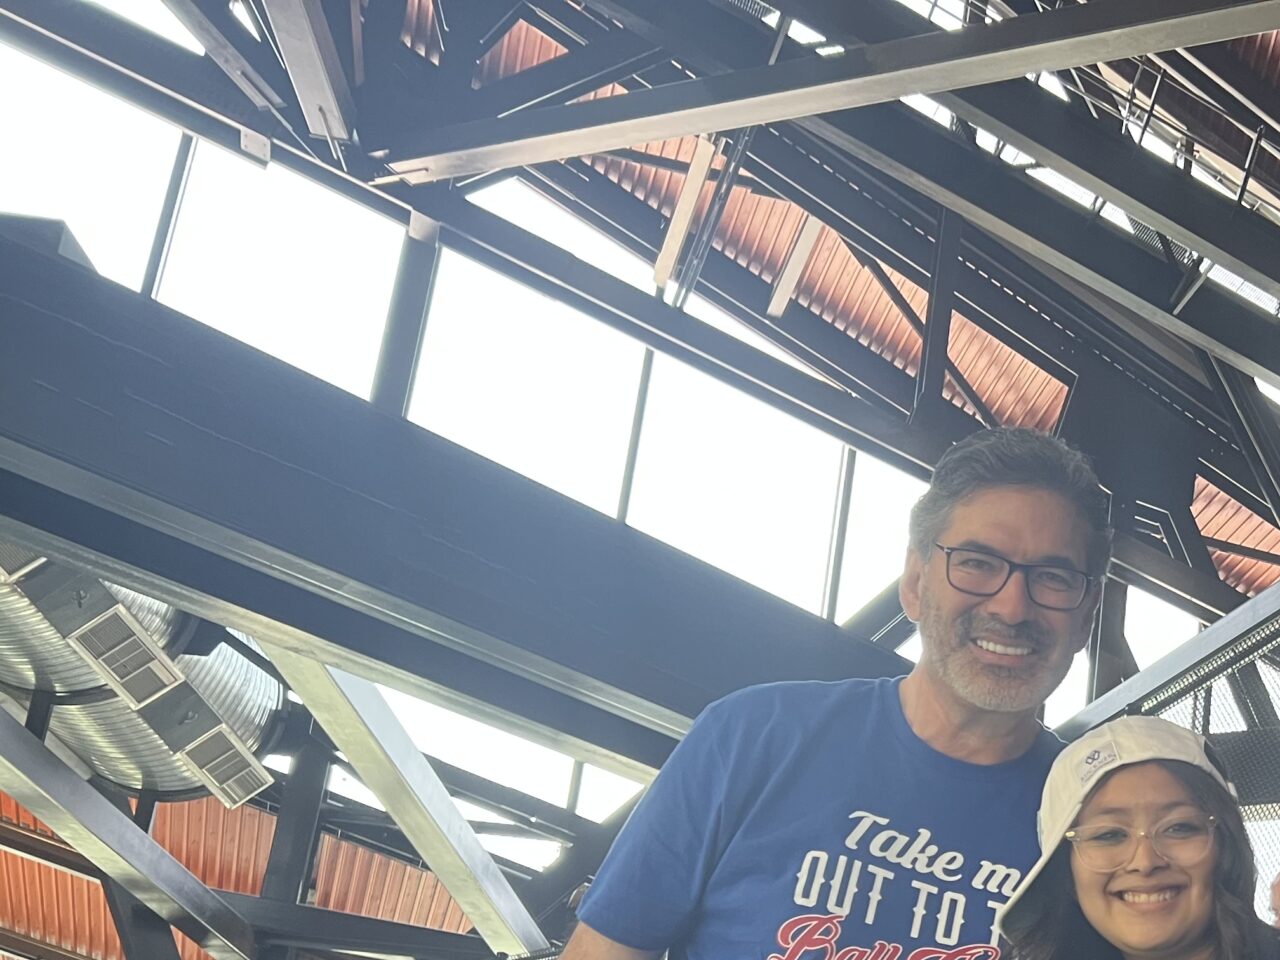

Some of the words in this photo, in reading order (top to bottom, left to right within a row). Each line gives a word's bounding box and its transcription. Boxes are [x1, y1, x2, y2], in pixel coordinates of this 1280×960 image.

[844, 811, 964, 882] Take
[794, 850, 895, 925] OUT
[910, 880, 966, 947] TO
